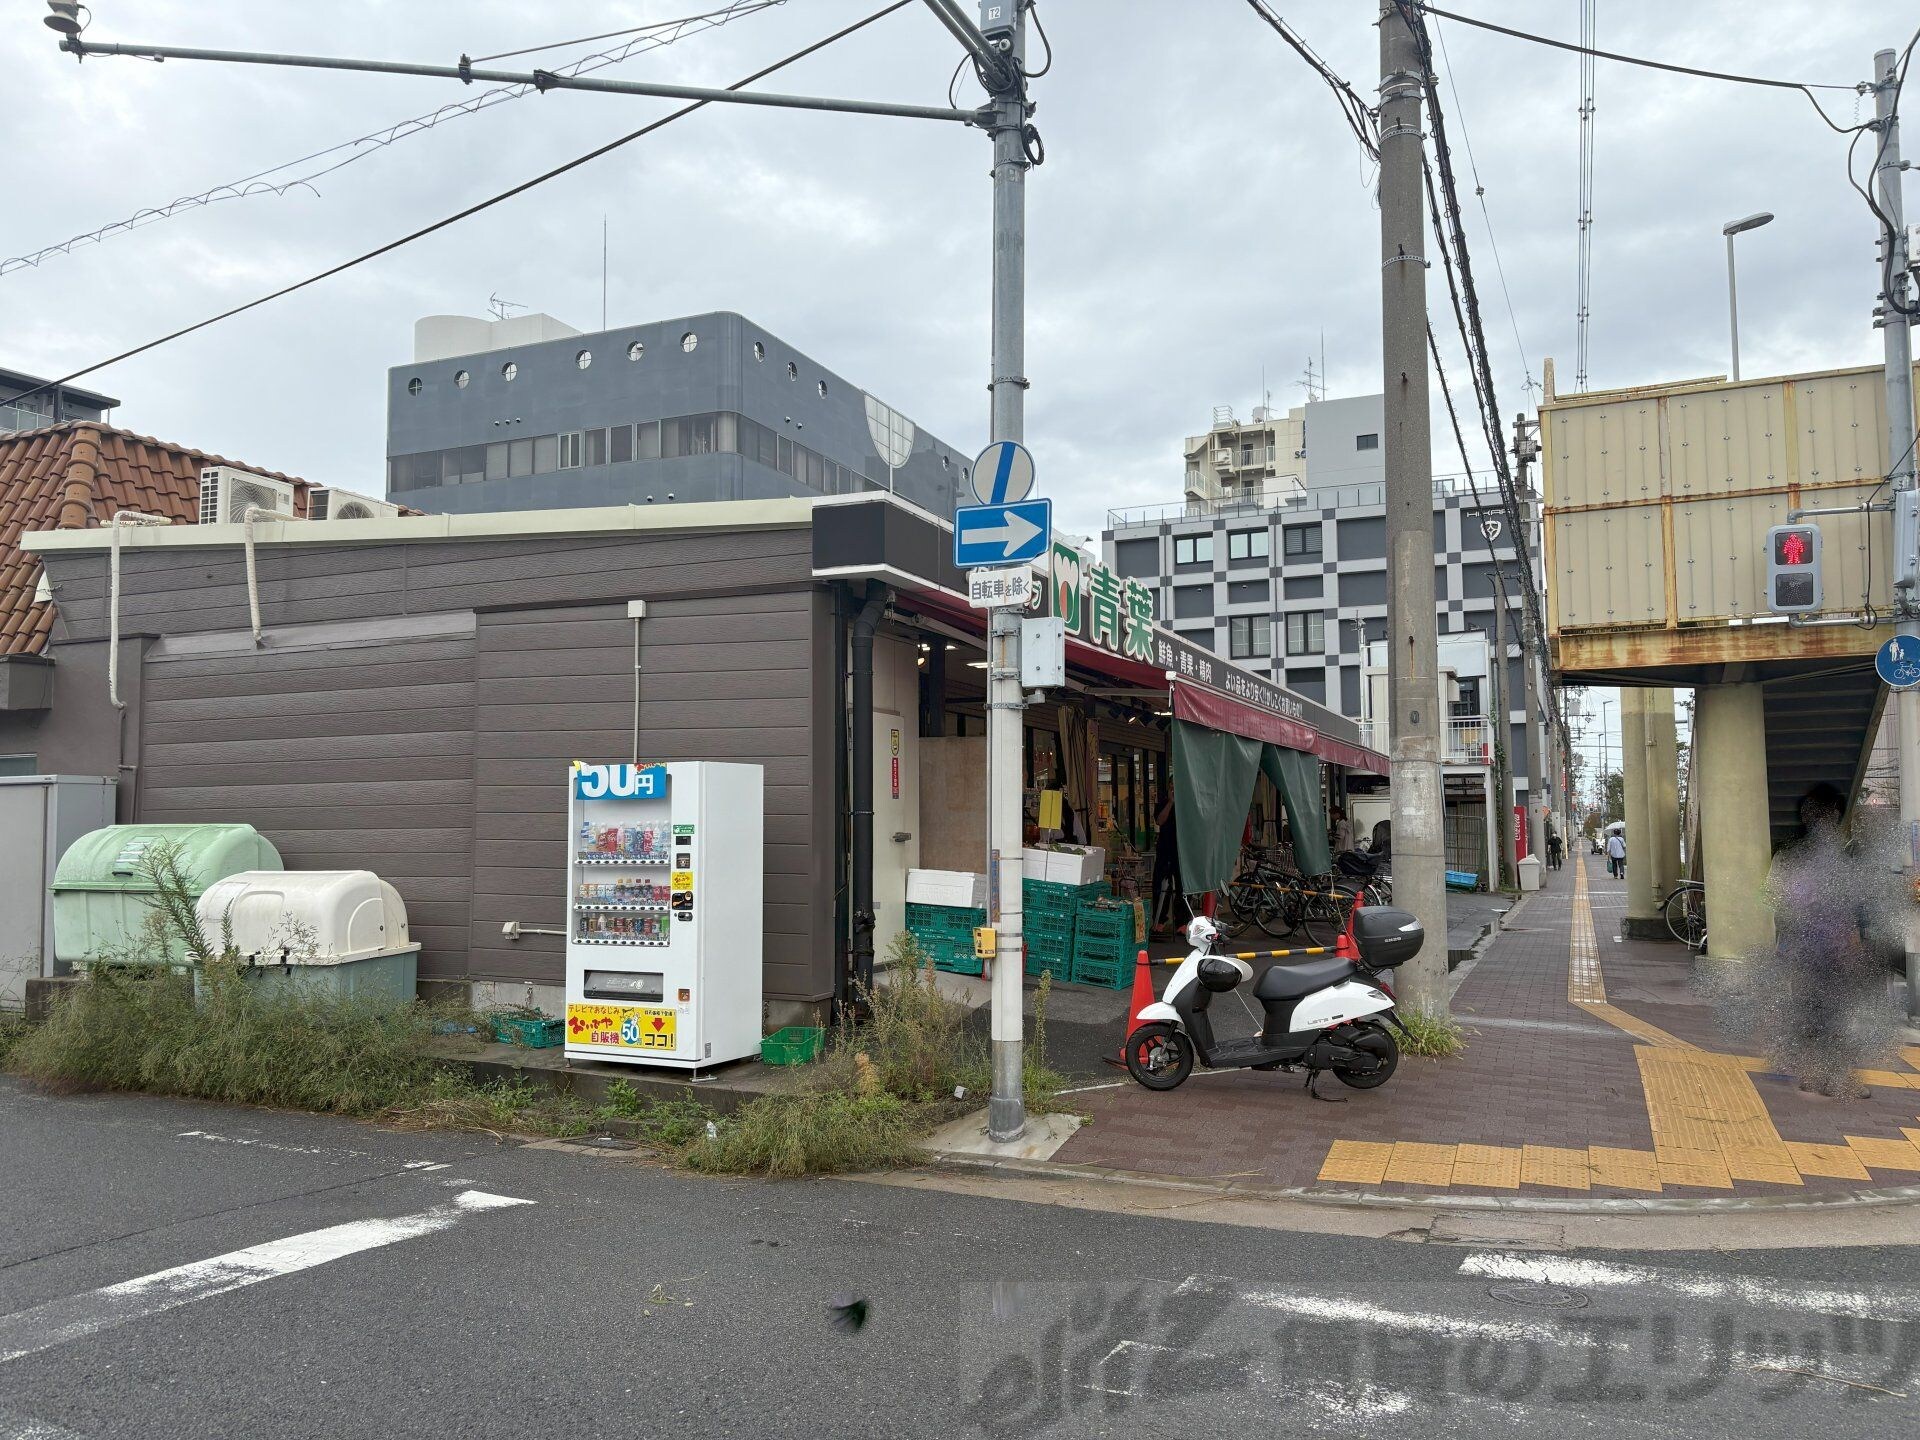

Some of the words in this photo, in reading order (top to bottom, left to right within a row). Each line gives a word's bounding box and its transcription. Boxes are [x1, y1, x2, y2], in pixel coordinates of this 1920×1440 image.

[990, 8, 1000, 18] T2
[971, 576, 1030, 600] 自転車を除く
[1088, 562, 1154, 665] 青葉
[568, 1004, 621, 1015] テレビでおなじみ
[568, 1015, 613, 1035] おいでや
[591, 1030, 620, 1044] 自販機
